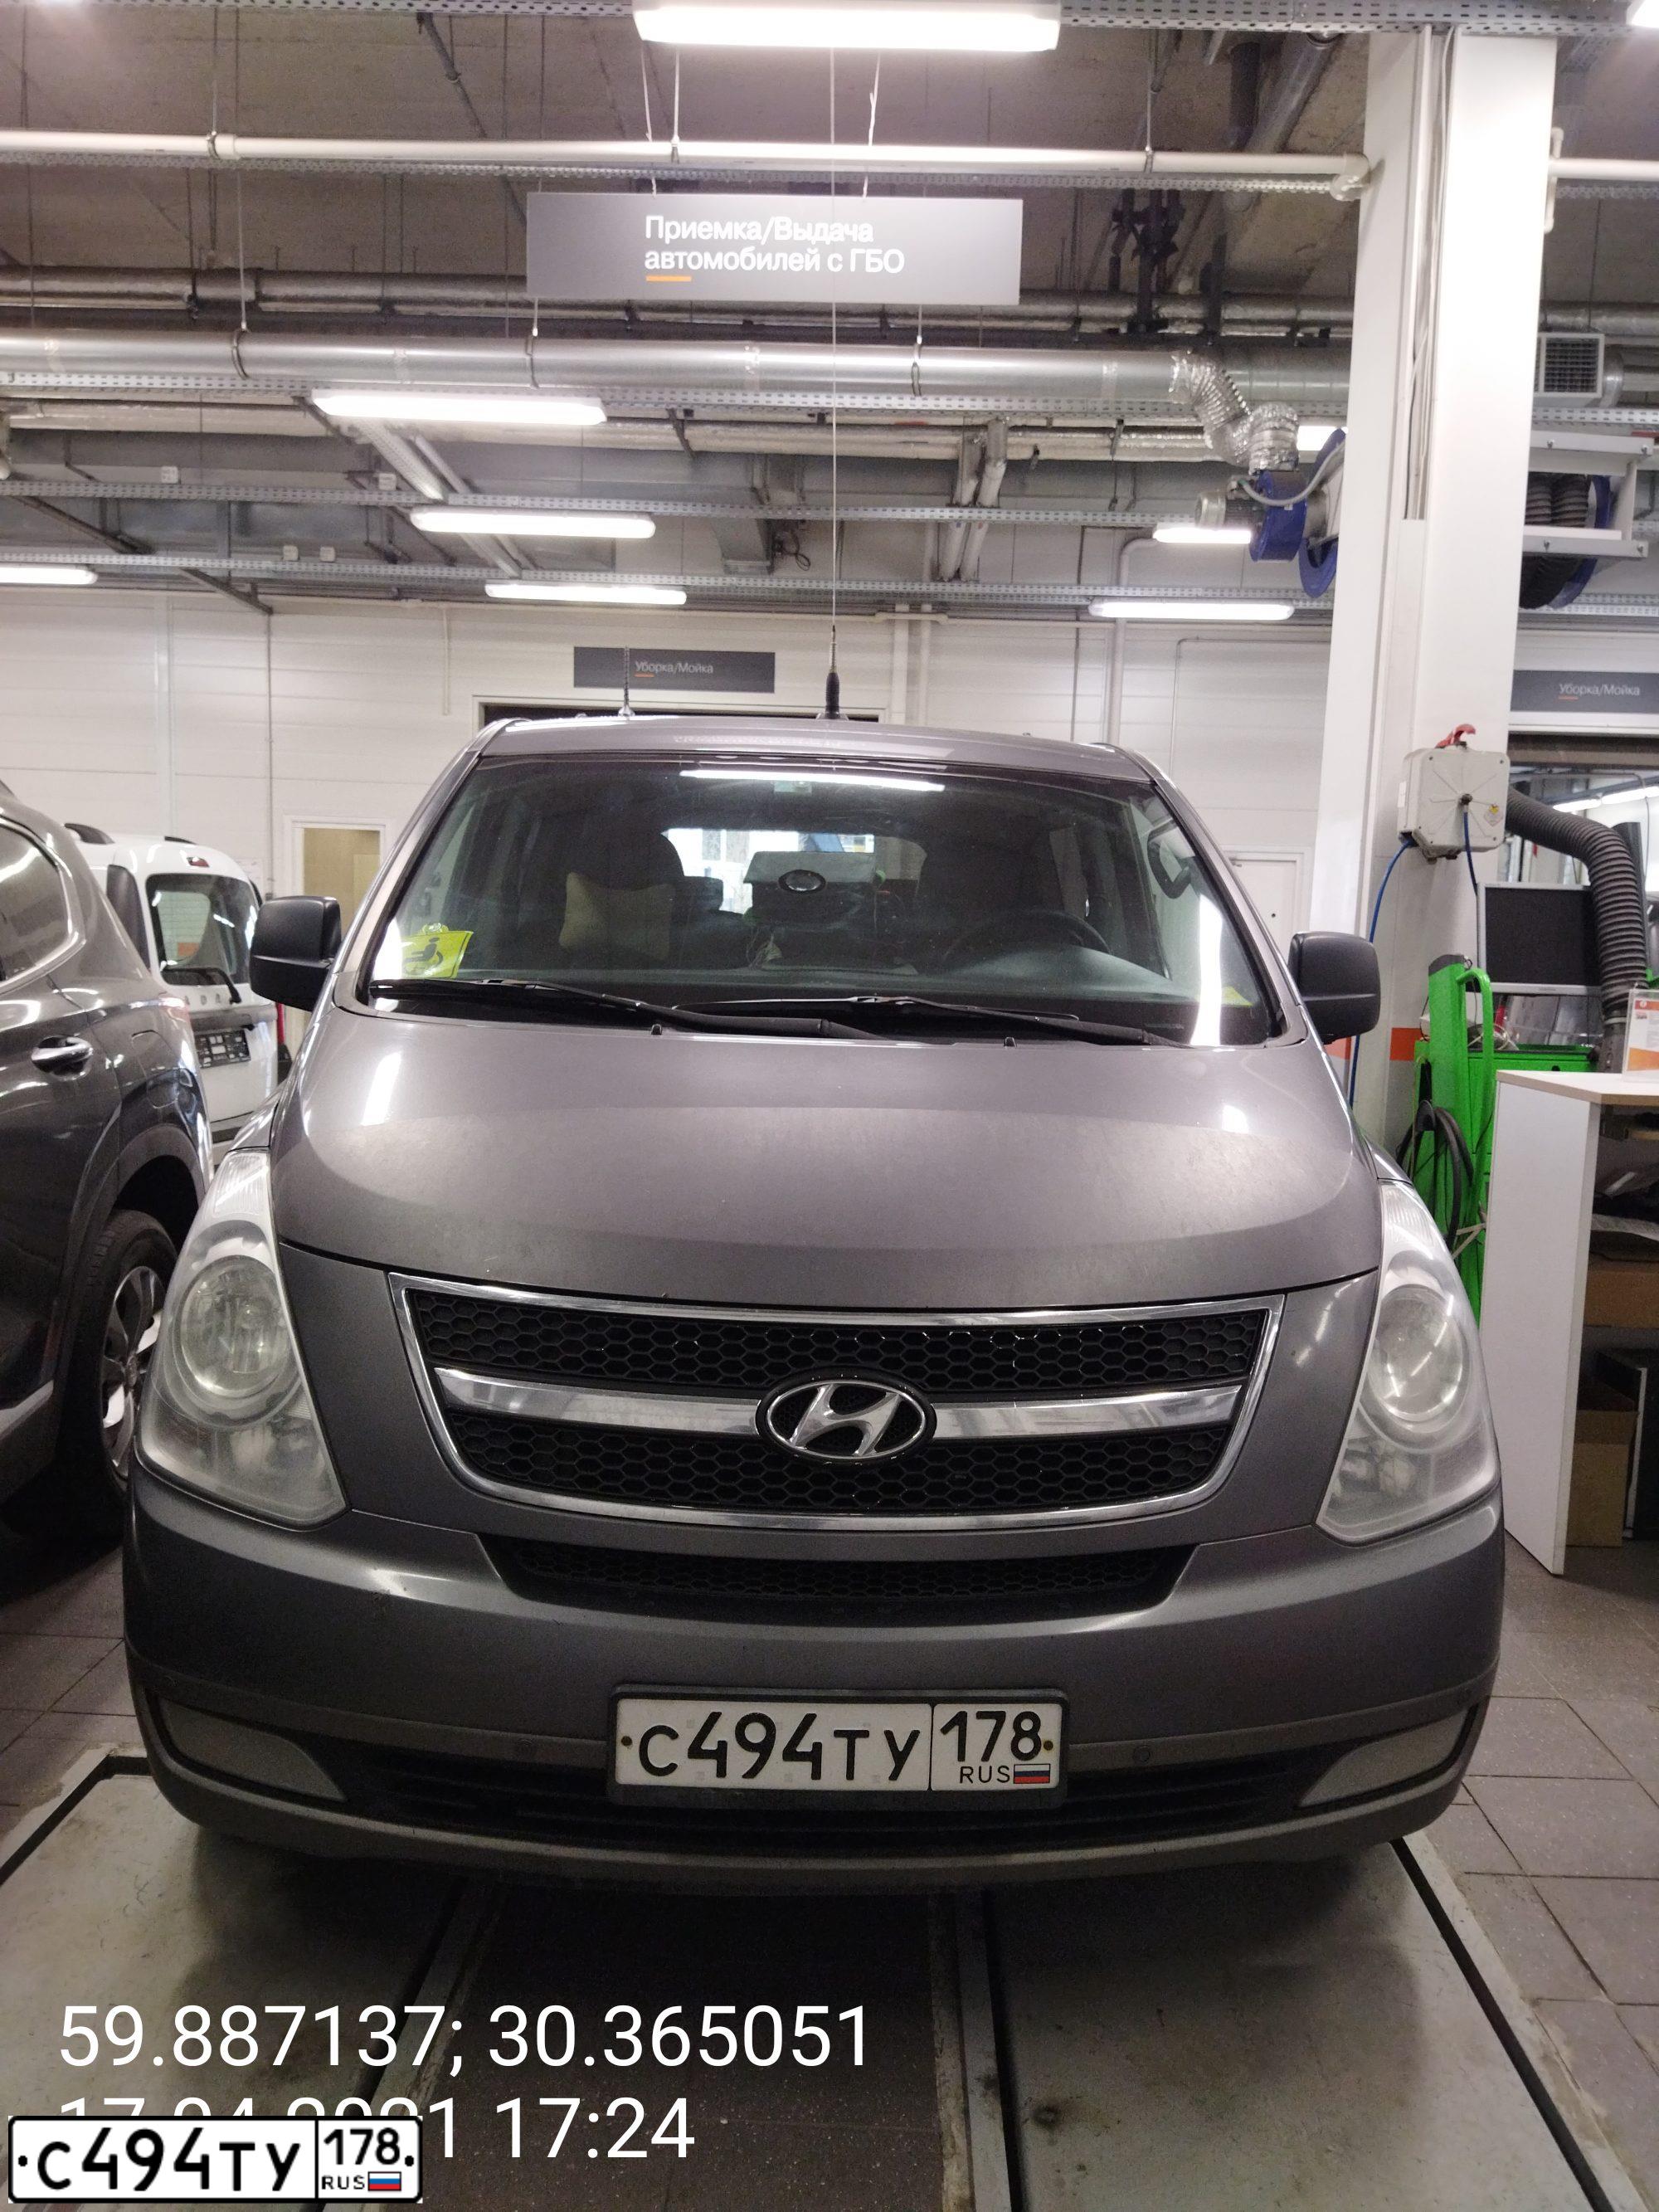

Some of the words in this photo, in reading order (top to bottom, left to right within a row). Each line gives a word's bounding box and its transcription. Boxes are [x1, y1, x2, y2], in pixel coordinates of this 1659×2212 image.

[645, 214, 875, 246] Приемка/Выдача
[644, 246, 821, 272] автомобилей
[826, 252, 844, 272] с
[849, 247, 905, 275] ГБО
[635, 660, 714, 675] Уборка/Мойка
[1559, 683, 1641, 697] Уборка/Мойка
[638, 1711, 921, 1781] С494ТУ
[940, 1710, 1043, 1762] 178
[959, 1765, 1010, 1784] RUS
